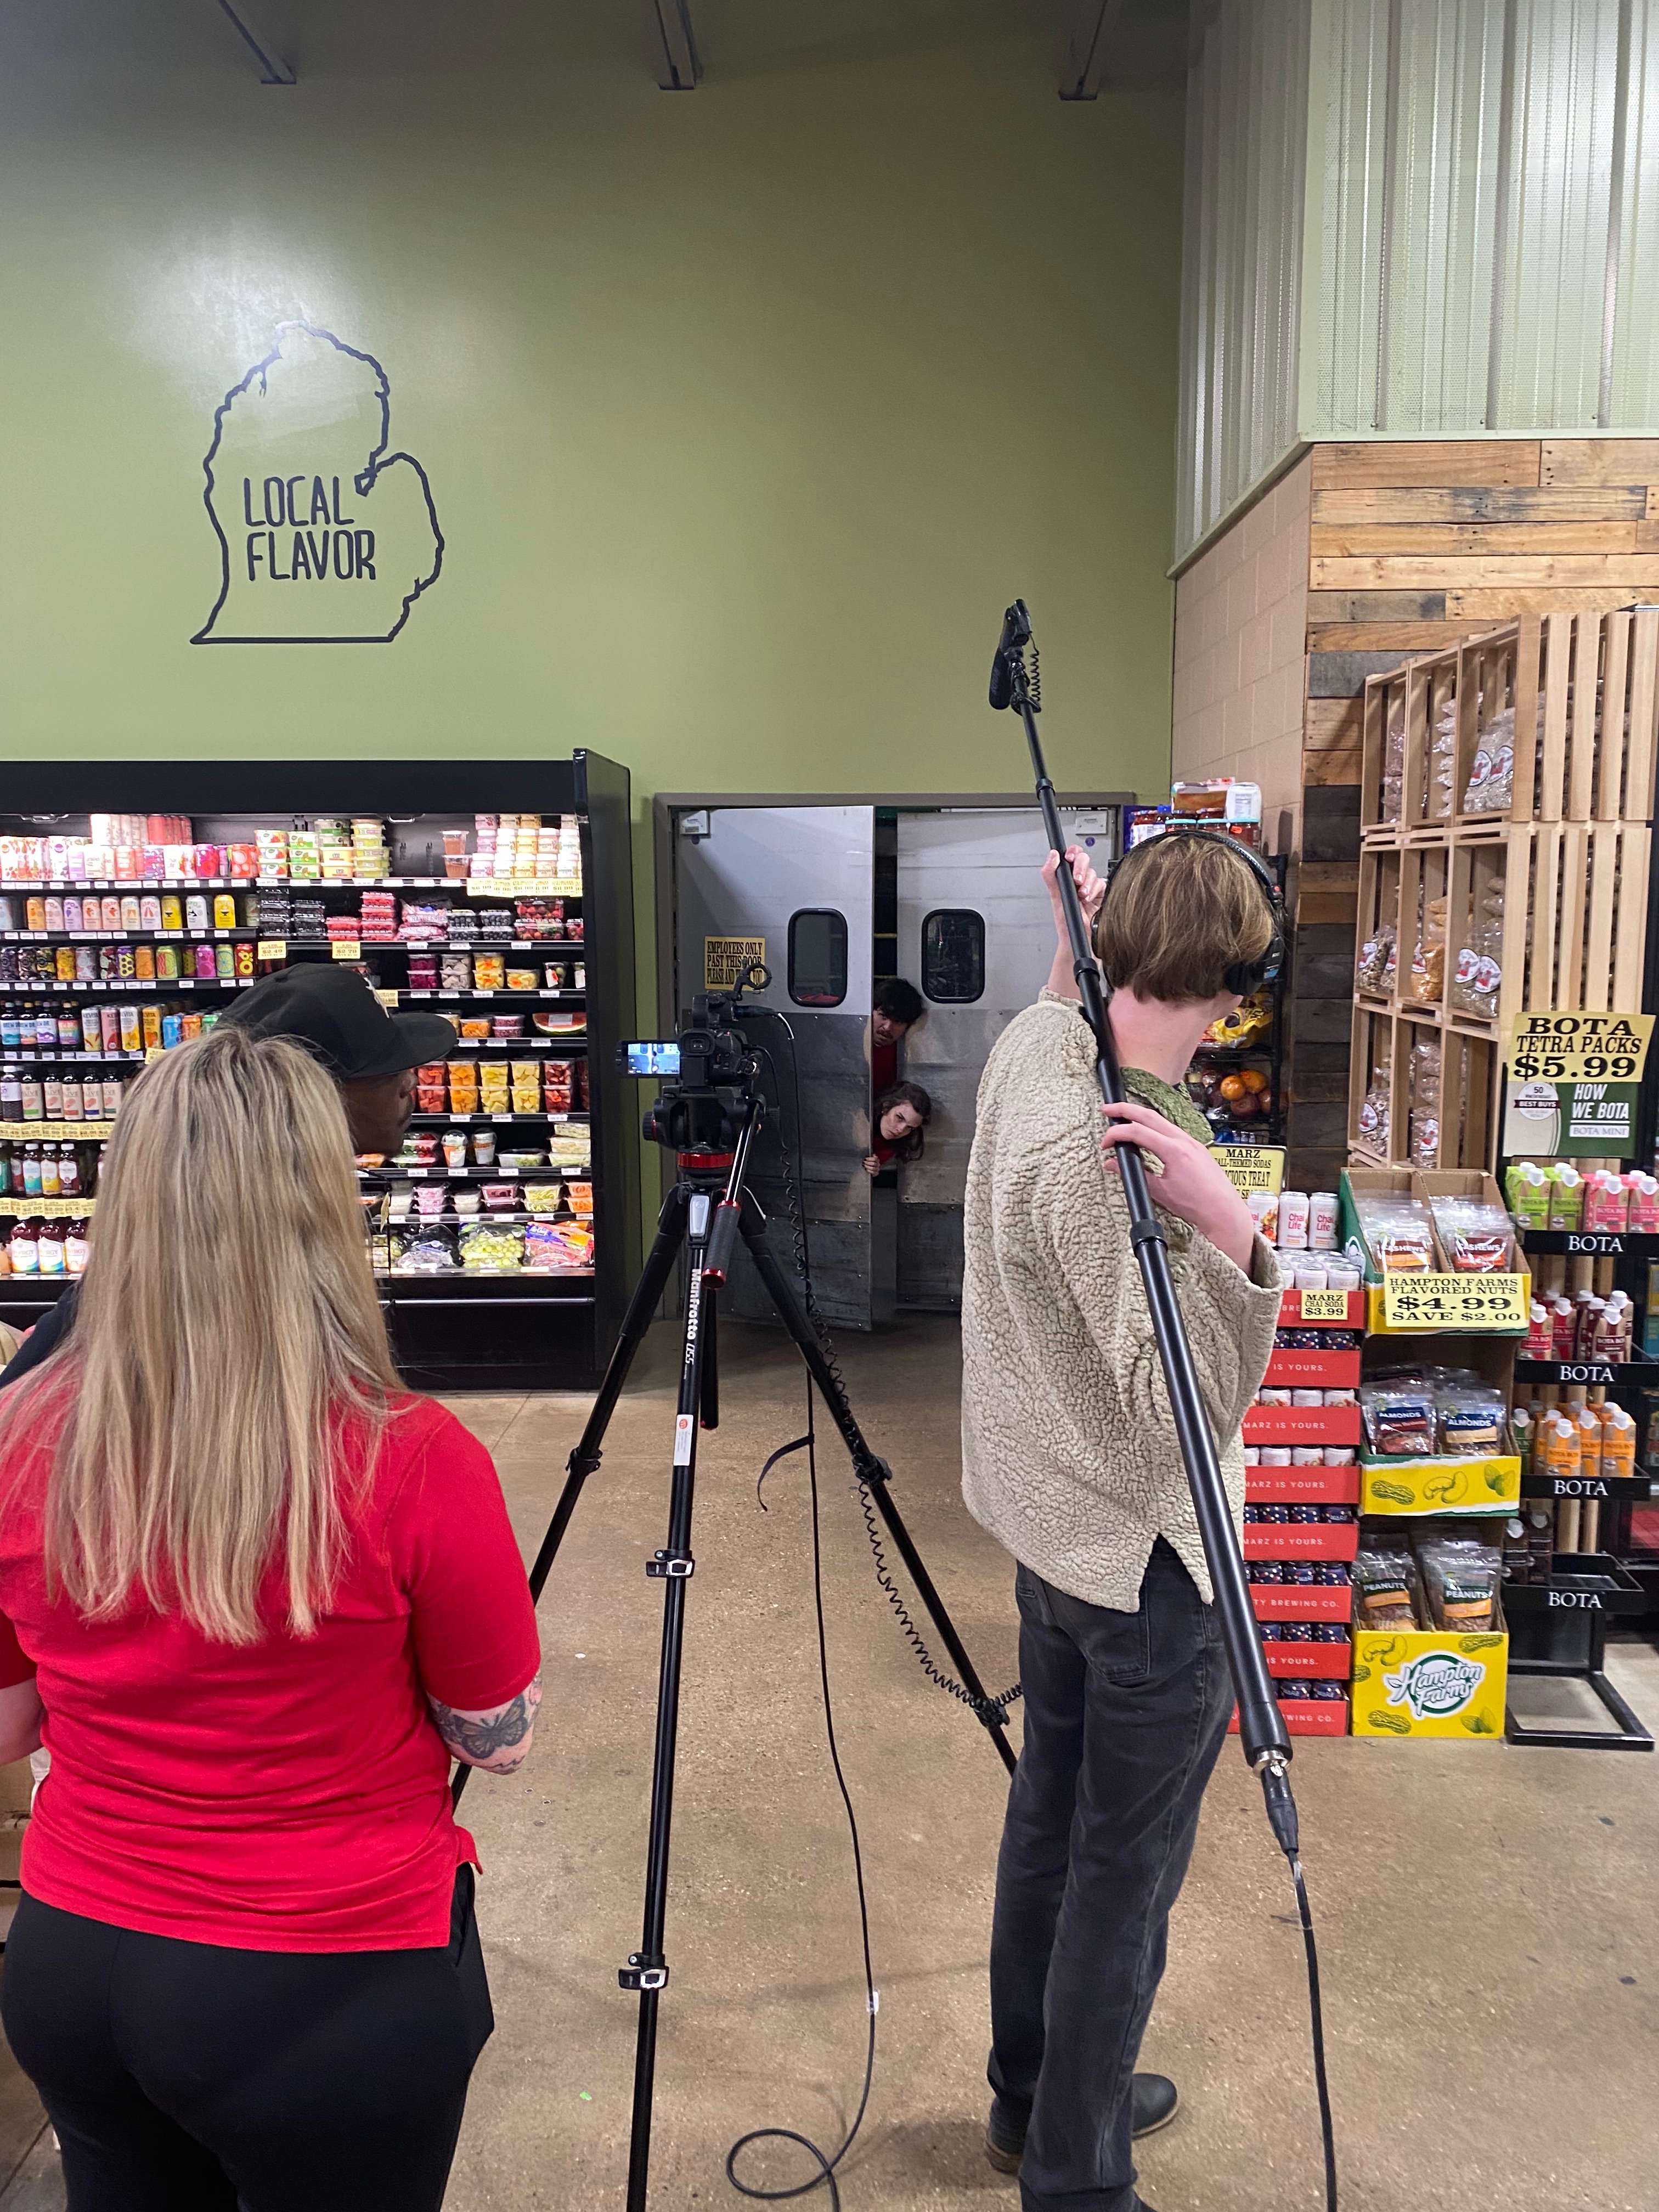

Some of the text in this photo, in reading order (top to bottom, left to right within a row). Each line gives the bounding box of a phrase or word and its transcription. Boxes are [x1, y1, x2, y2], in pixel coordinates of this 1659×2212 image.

[244, 476, 354, 527] LOCAL
[247, 529, 376, 581] FLAVOR
[707, 940, 763, 955] EMPLOYEES ONLY
[707, 955, 724, 967] PAST
[725, 955, 742, 968] THIS
[724, 968, 735, 985] AND
[1525, 1018, 1636, 1036] BOTA
[1516, 1036, 1642, 1054] TETRA PACKS
[1514, 1053, 1636, 1081] $5.99
[1574, 1084, 1608, 1100] HOW
[1572, 1102, 1629, 1119] WE BOTA
[1226, 1149, 1261, 1158] MARZ
[1253, 1159, 1272, 1169] SODAS
[1249, 1171, 1271, 1187] TREAT
[1289, 1213, 1305, 1222] Chai
[1317, 1215, 1334, 1223] Chai
[1317, 1223, 1330, 1231] Life
[1568, 1235, 1623, 1252] BOTA
[687, 1268, 702, 1340] Manfrotto
[1397, 1296, 1511, 1311] $4.99
[1305, 1307, 1344, 1317] $3.99
[1392, 1312, 1521, 1322] SAVE $2.00
[1560, 1365, 1615, 1382] BOTA
[1447, 1419, 1492, 1427] ALMONDS
[1554, 1480, 1609, 1496] BOTA
[1363, 1582, 1406, 1591] PEANUTS
[1445, 1590, 1487, 1599] PEANUTS
[1548, 1592, 1603, 1609] BOTA
[1388, 1661, 1482, 1702] Hampton
[1414, 1681, 1473, 1717] Farms
